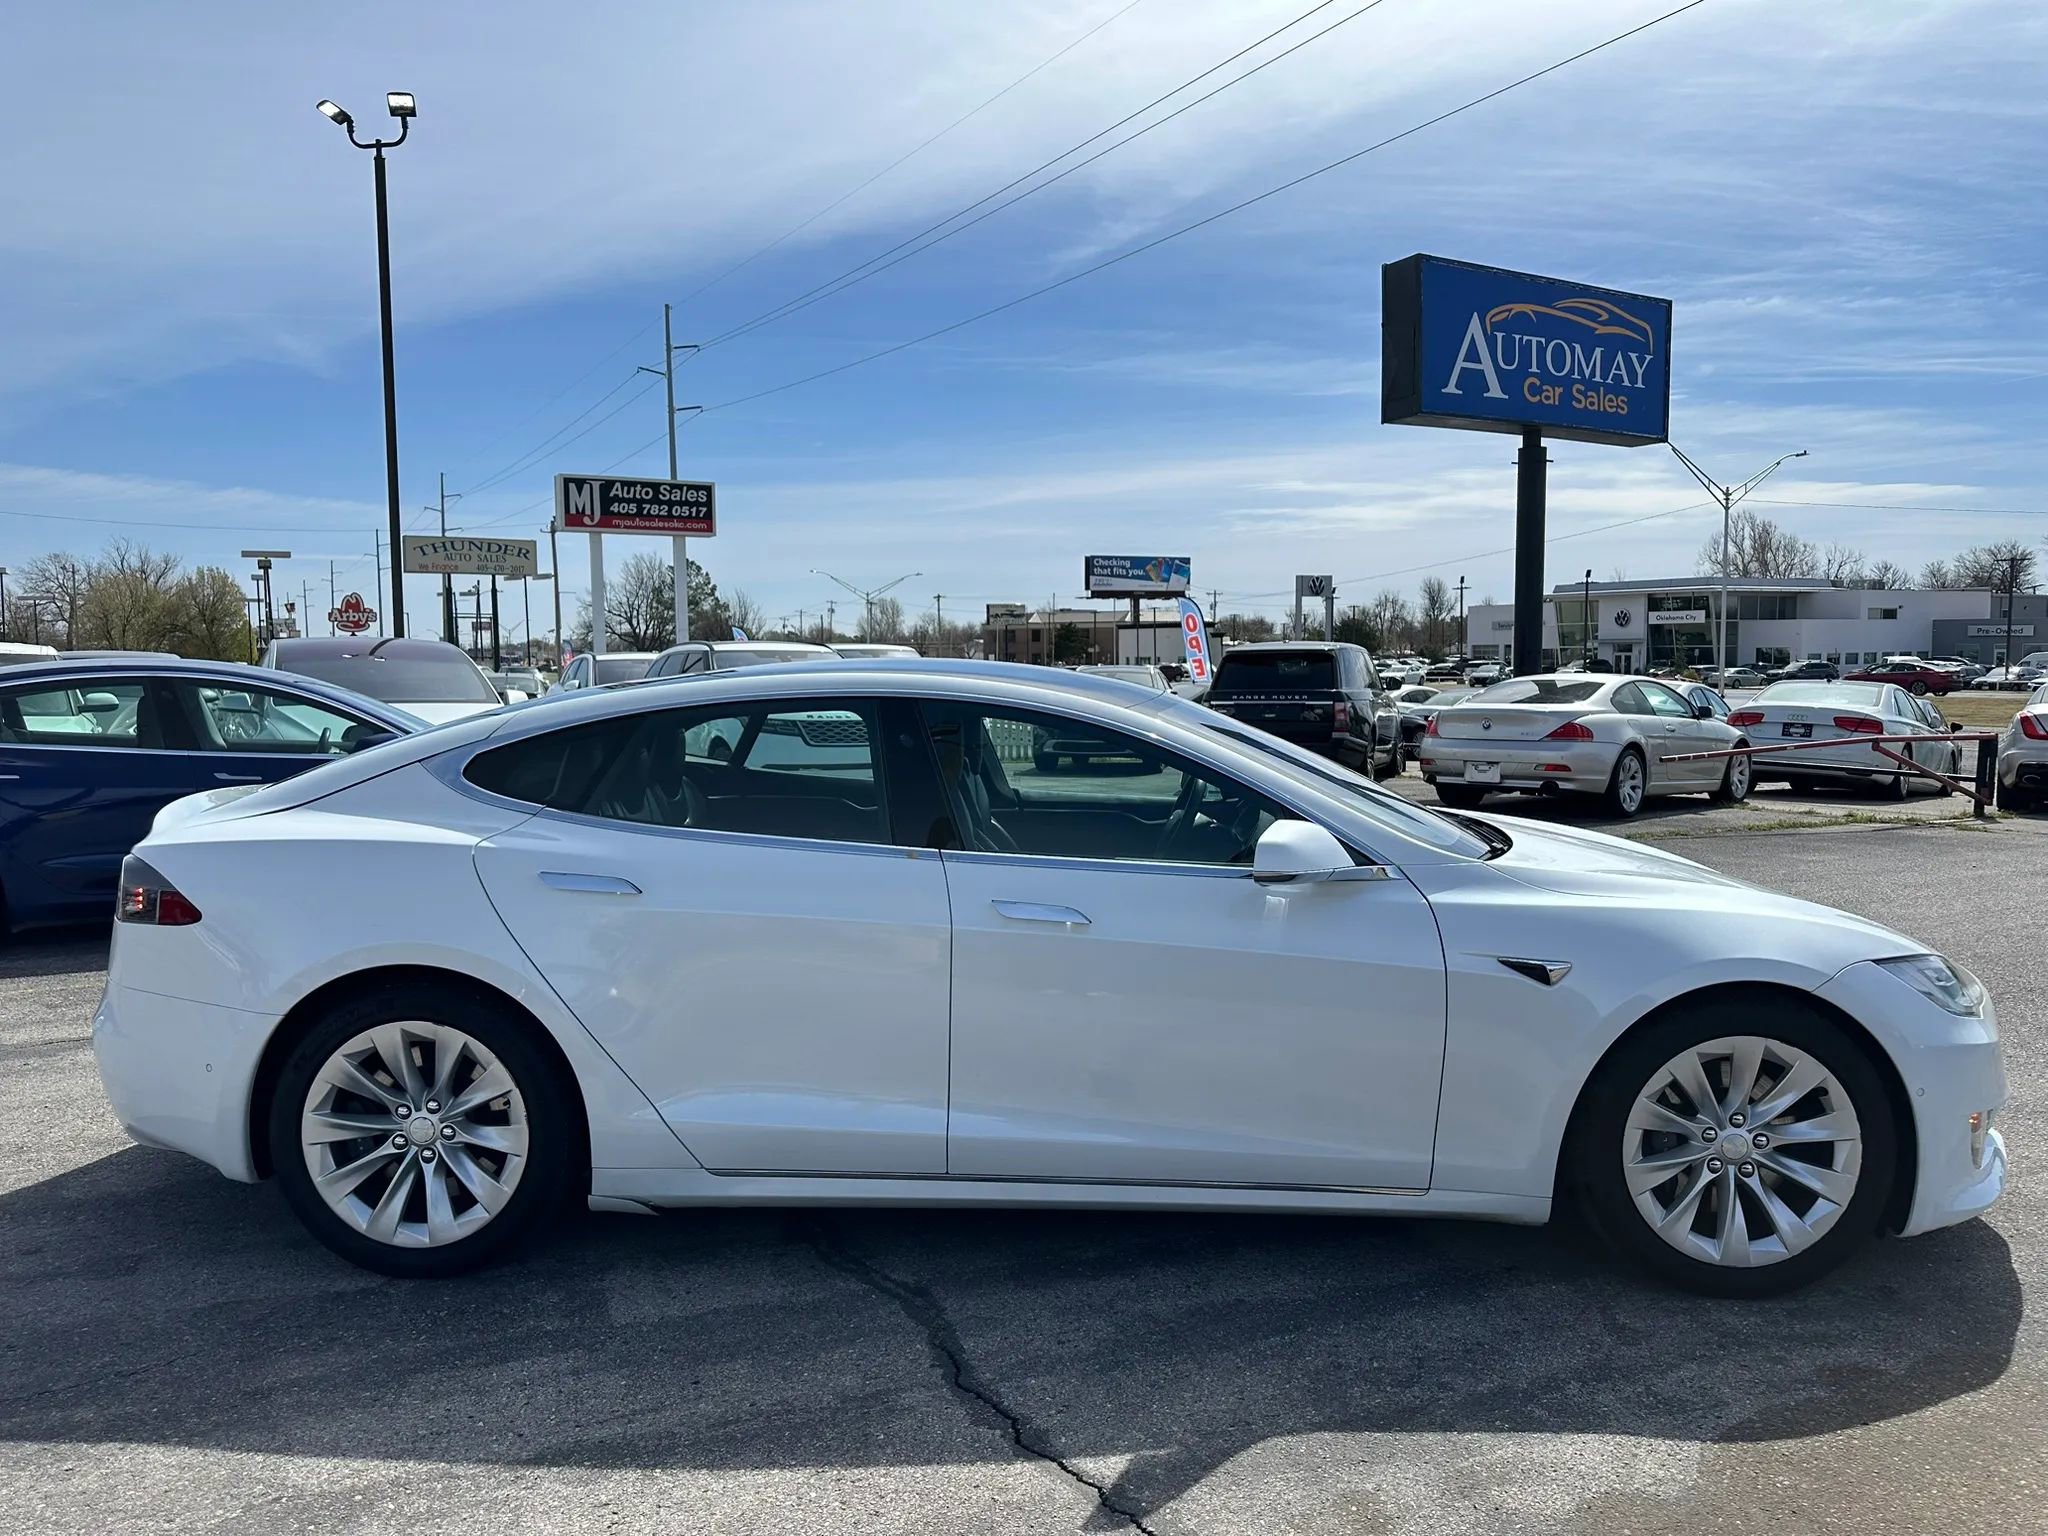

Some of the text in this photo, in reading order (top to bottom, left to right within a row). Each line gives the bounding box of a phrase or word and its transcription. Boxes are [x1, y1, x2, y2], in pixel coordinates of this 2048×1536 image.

[1441, 311, 1654, 400] AUTOMAY
[1523, 376, 1629, 415] Car Sales
[609, 481, 708, 502] Auto Sales
[568, 480, 605, 526] MJ
[609, 502, 708, 518] 405 782 0517
[612, 517, 708, 529] mjautosalesokc.com
[413, 540, 531, 560] THUNDER
[443, 552, 507, 563] AUTO SALES
[418, 562, 459, 571] We Finance
[1093, 558, 1131, 568] Checking
[1093, 567, 1146, 577] that fits you.
[330, 609, 376, 625] Arby's
